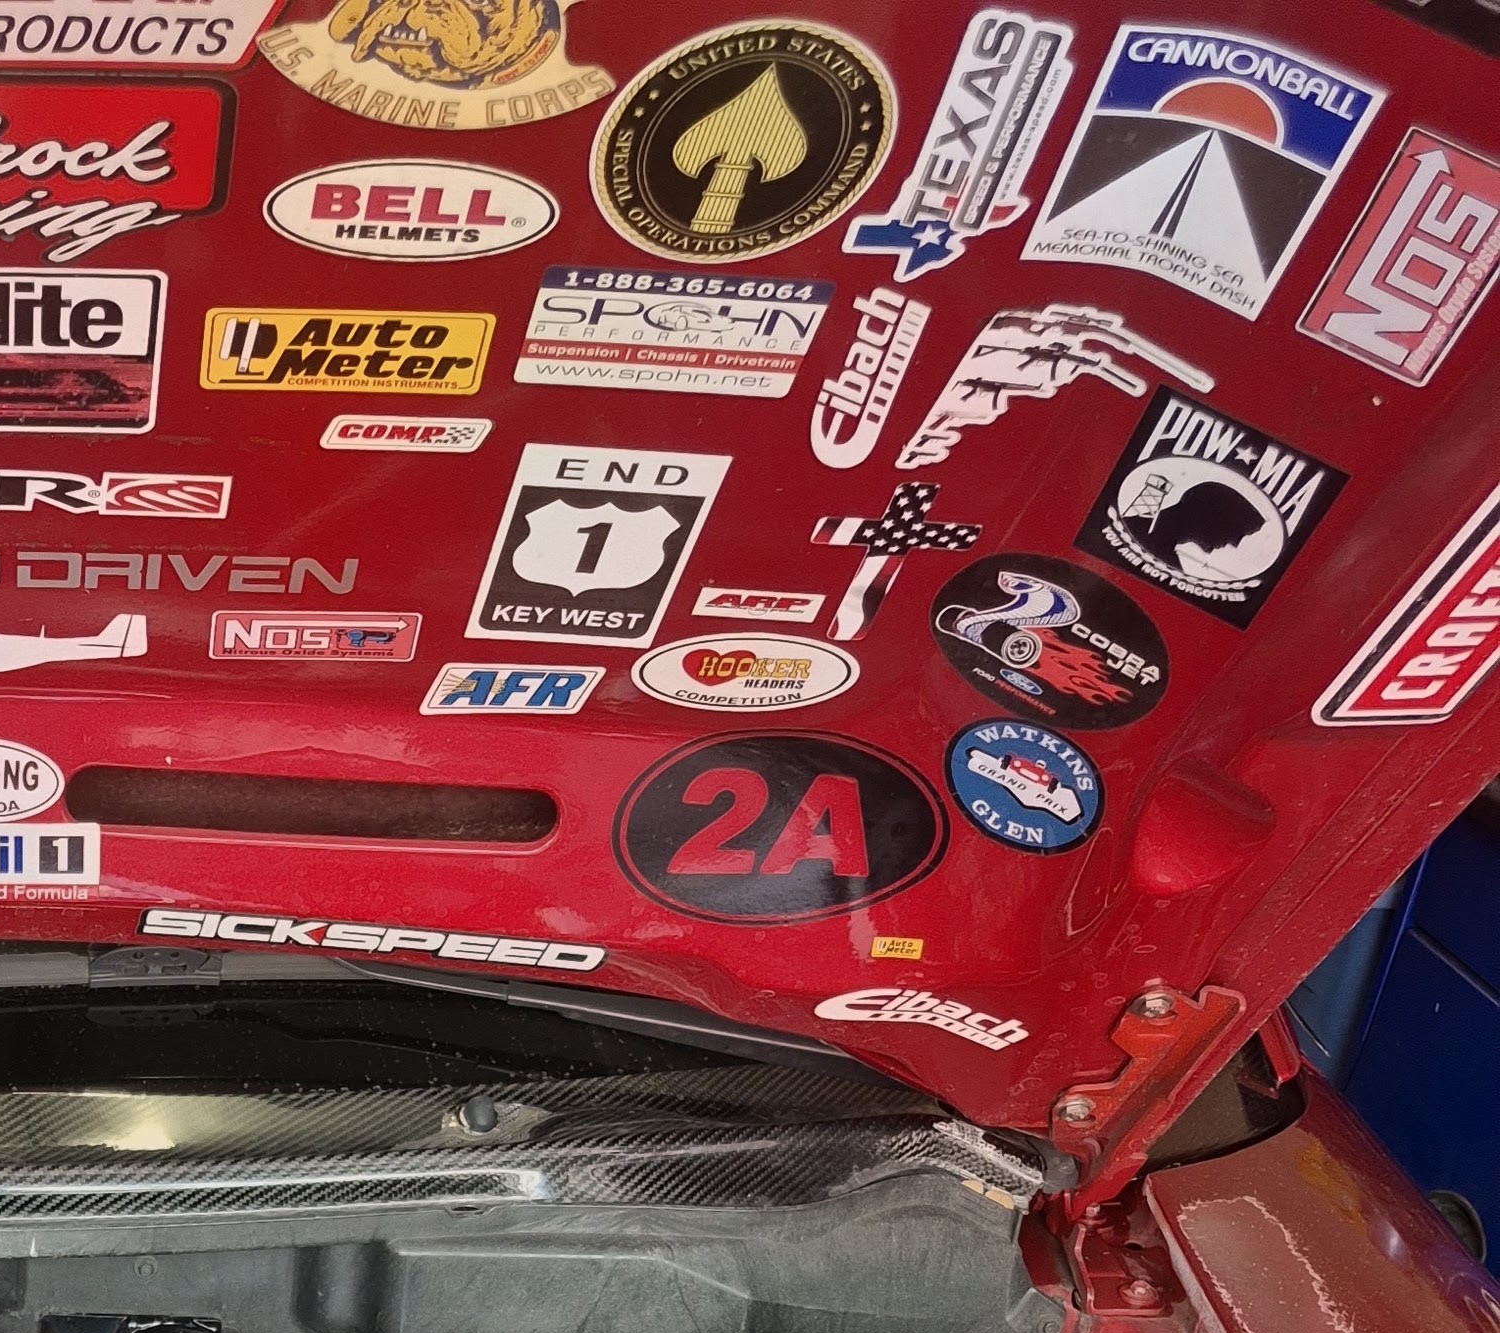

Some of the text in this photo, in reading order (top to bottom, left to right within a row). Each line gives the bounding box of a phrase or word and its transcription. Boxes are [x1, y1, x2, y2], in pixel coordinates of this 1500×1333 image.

[259, 28, 613, 129] U.S. MARINE CORPS
[668, 34, 868, 93] UNITED STATES
[1126, 35, 1359, 122] CANNONBALL
[994, 38, 1053, 159] PERFORMANCE
[902, 18, 1026, 226] TEXAS
[310, 183, 506, 227] BELL
[610, 126, 869, 254] SPECIAL OPERATIONS COMMAND
[335, 224, 481, 244] HELMETS
[1061, 228, 1245, 287] SEA-TO-SHINING SEA
[1323, 165, 1500, 366] NOS
[564, 271, 814, 301] 1-888-365-6064
[1138, 251, 1208, 286] TROPHY
[1209, 281, 1257, 311] DASH
[287, 318, 450, 349] Auto
[533, 324, 806, 351] PERFORMANCE
[267, 349, 475, 384] Meter
[527, 342, 798, 370] Suspension Chassis Drivetrain
[535, 363, 773, 389] www.spohn.net
[287, 377, 458, 390] COMPETITION INSTRUMENTS
[810, 287, 915, 469] Eibach
[338, 424, 447, 442] COMP
[555, 458, 690, 487] END
[1136, 397, 1327, 538] POW MIA
[574, 522, 613, 574] 1
[1101, 526, 1248, 602] YOU ARE NOT FORGOTTEN
[16, 552, 357, 595] DRIVEN
[491, 603, 646, 631] KEY WEST
[704, 593, 813, 614] ARP
[222, 648, 394, 658] Nitrous Oxide Systems
[224, 619, 332, 650] NOS
[1071, 623, 1162, 681] COBRA
[698, 656, 813, 680] HOOKER
[742, 678, 807, 691] HEADERS
[1106, 657, 1158, 686] JET
[440, 670, 587, 707] AFR
[674, 689, 802, 706] COMPETITION
[975, 724, 1094, 792] WATKINS
[977, 763, 1068, 815] GRAND PRIX
[666, 768, 870, 877] 2A
[971, 799, 1045, 844] GLEN
[14, 884, 89, 901] Formula
[141, 909, 609, 971] SICKSPEED
[885, 946, 918, 956] Meter
[887, 939, 915, 949] Auto
[814, 988, 1030, 1048] Eibach
